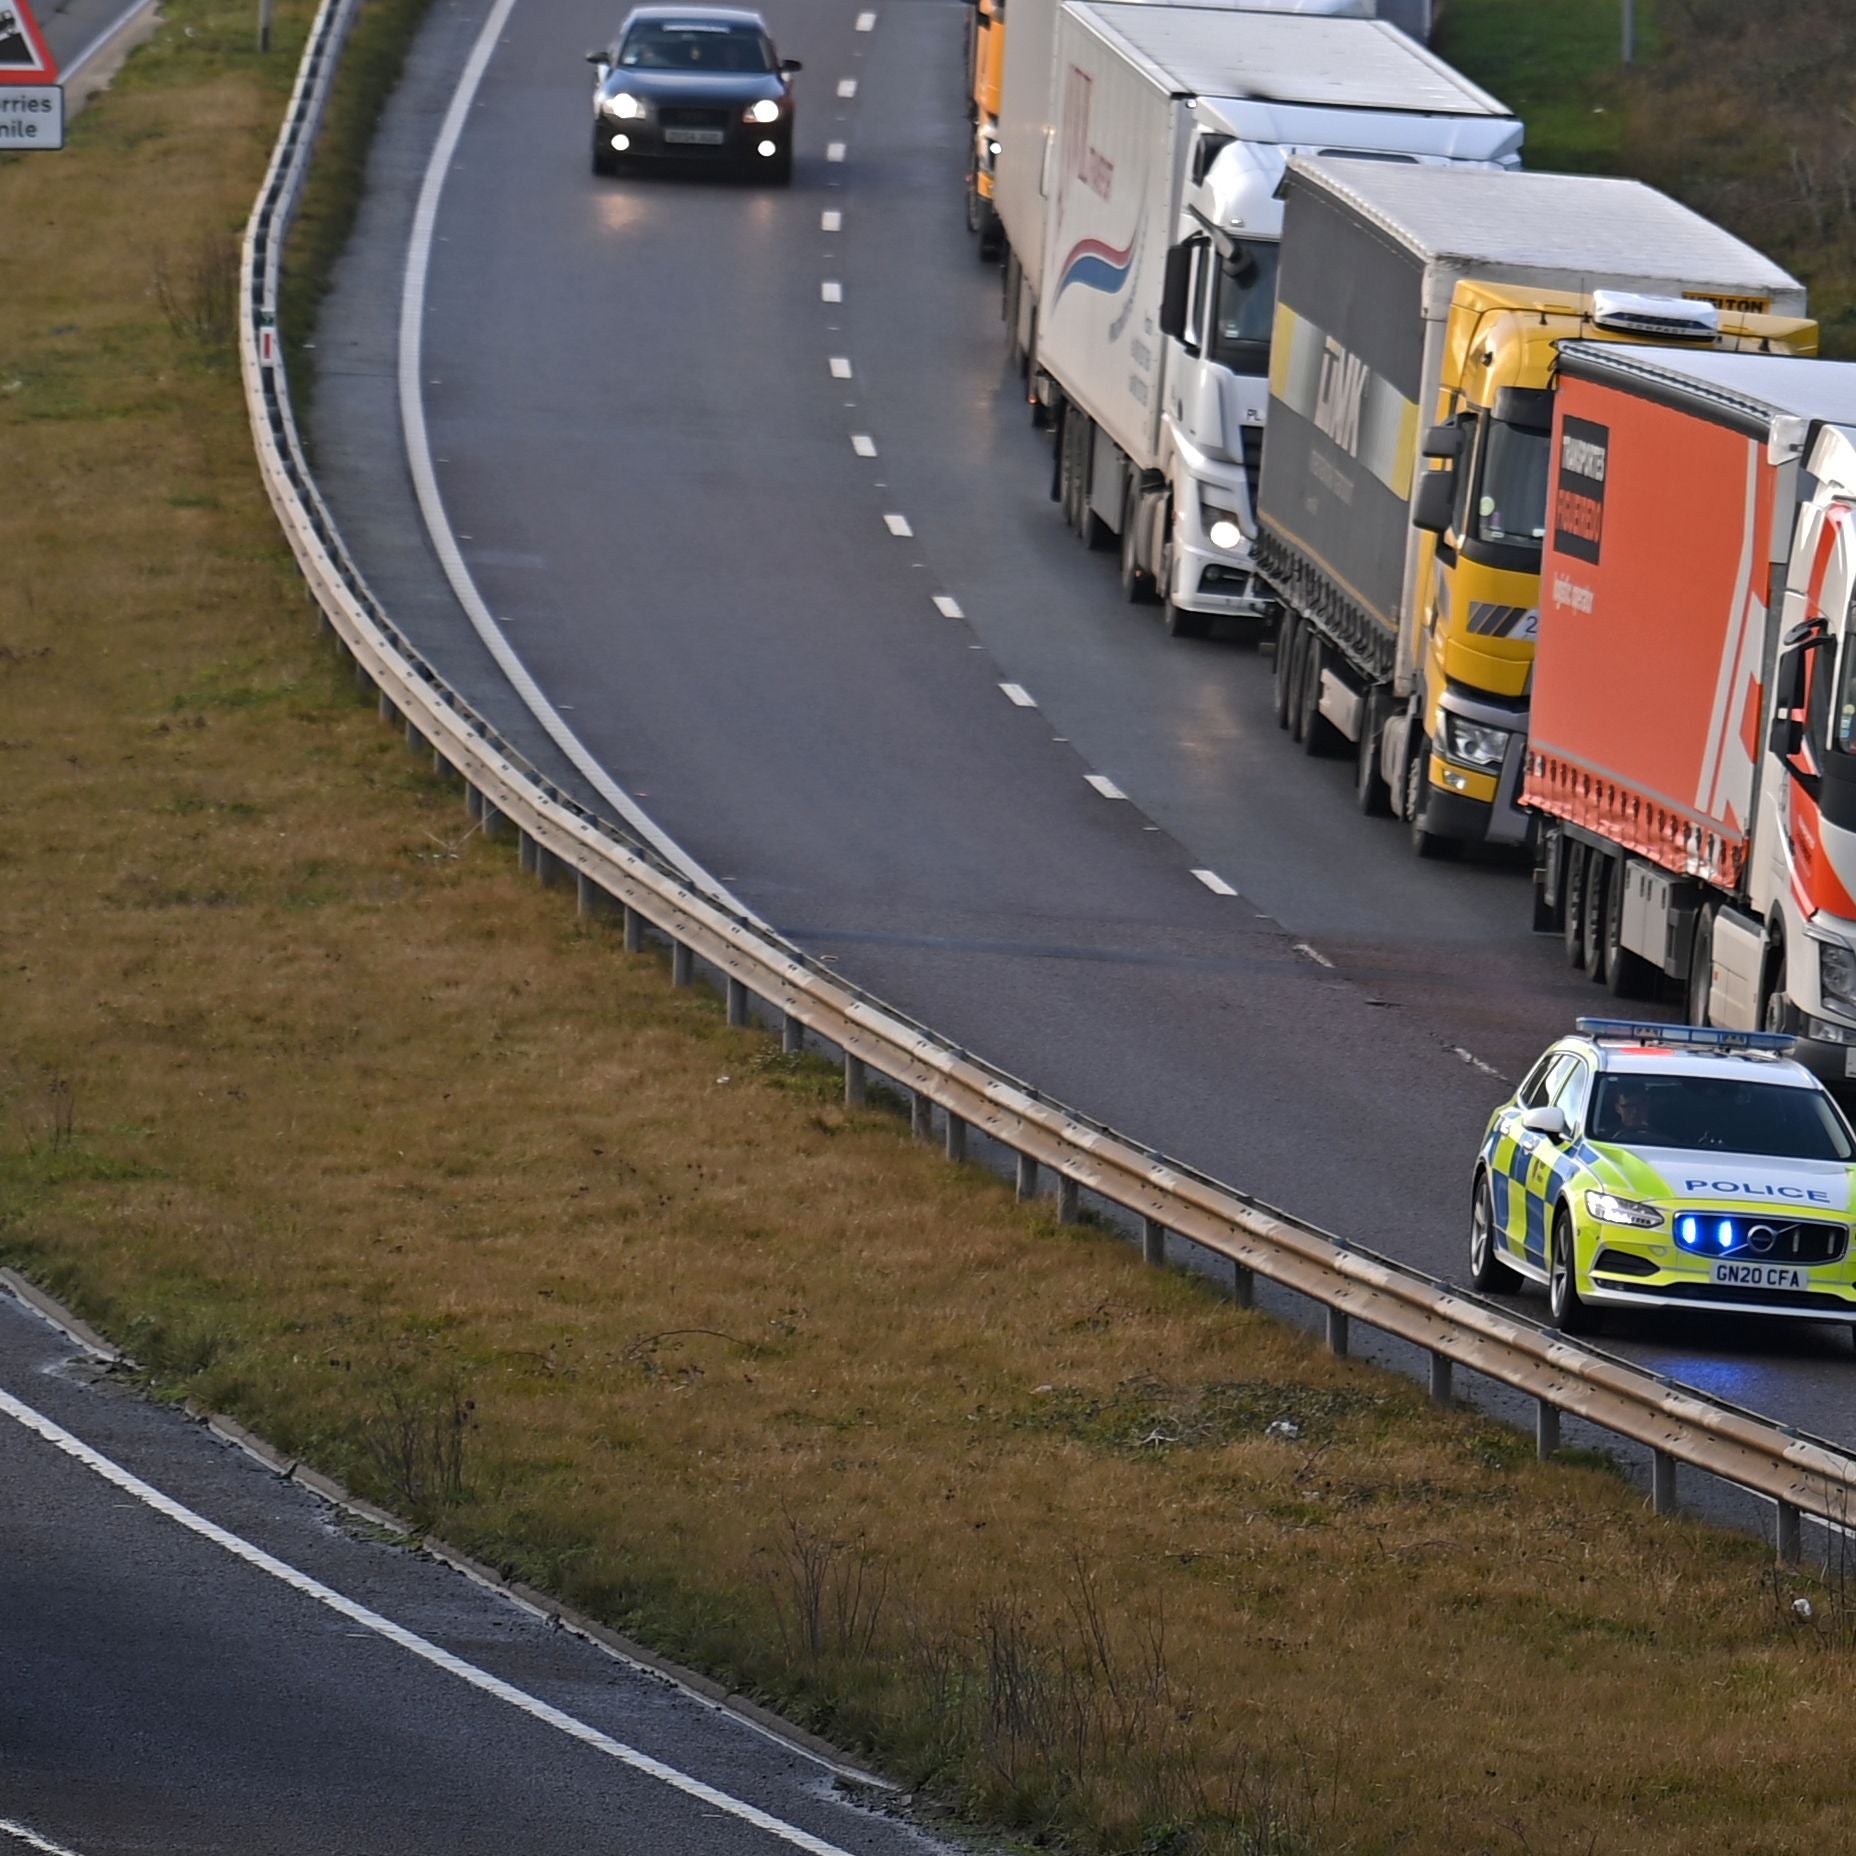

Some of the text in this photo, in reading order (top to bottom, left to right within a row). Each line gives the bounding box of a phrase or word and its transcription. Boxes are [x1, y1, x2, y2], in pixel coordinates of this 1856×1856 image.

[1685, 1180, 1831, 1204] POLICE
[1716, 1264, 1800, 1288] GN20 CFA
